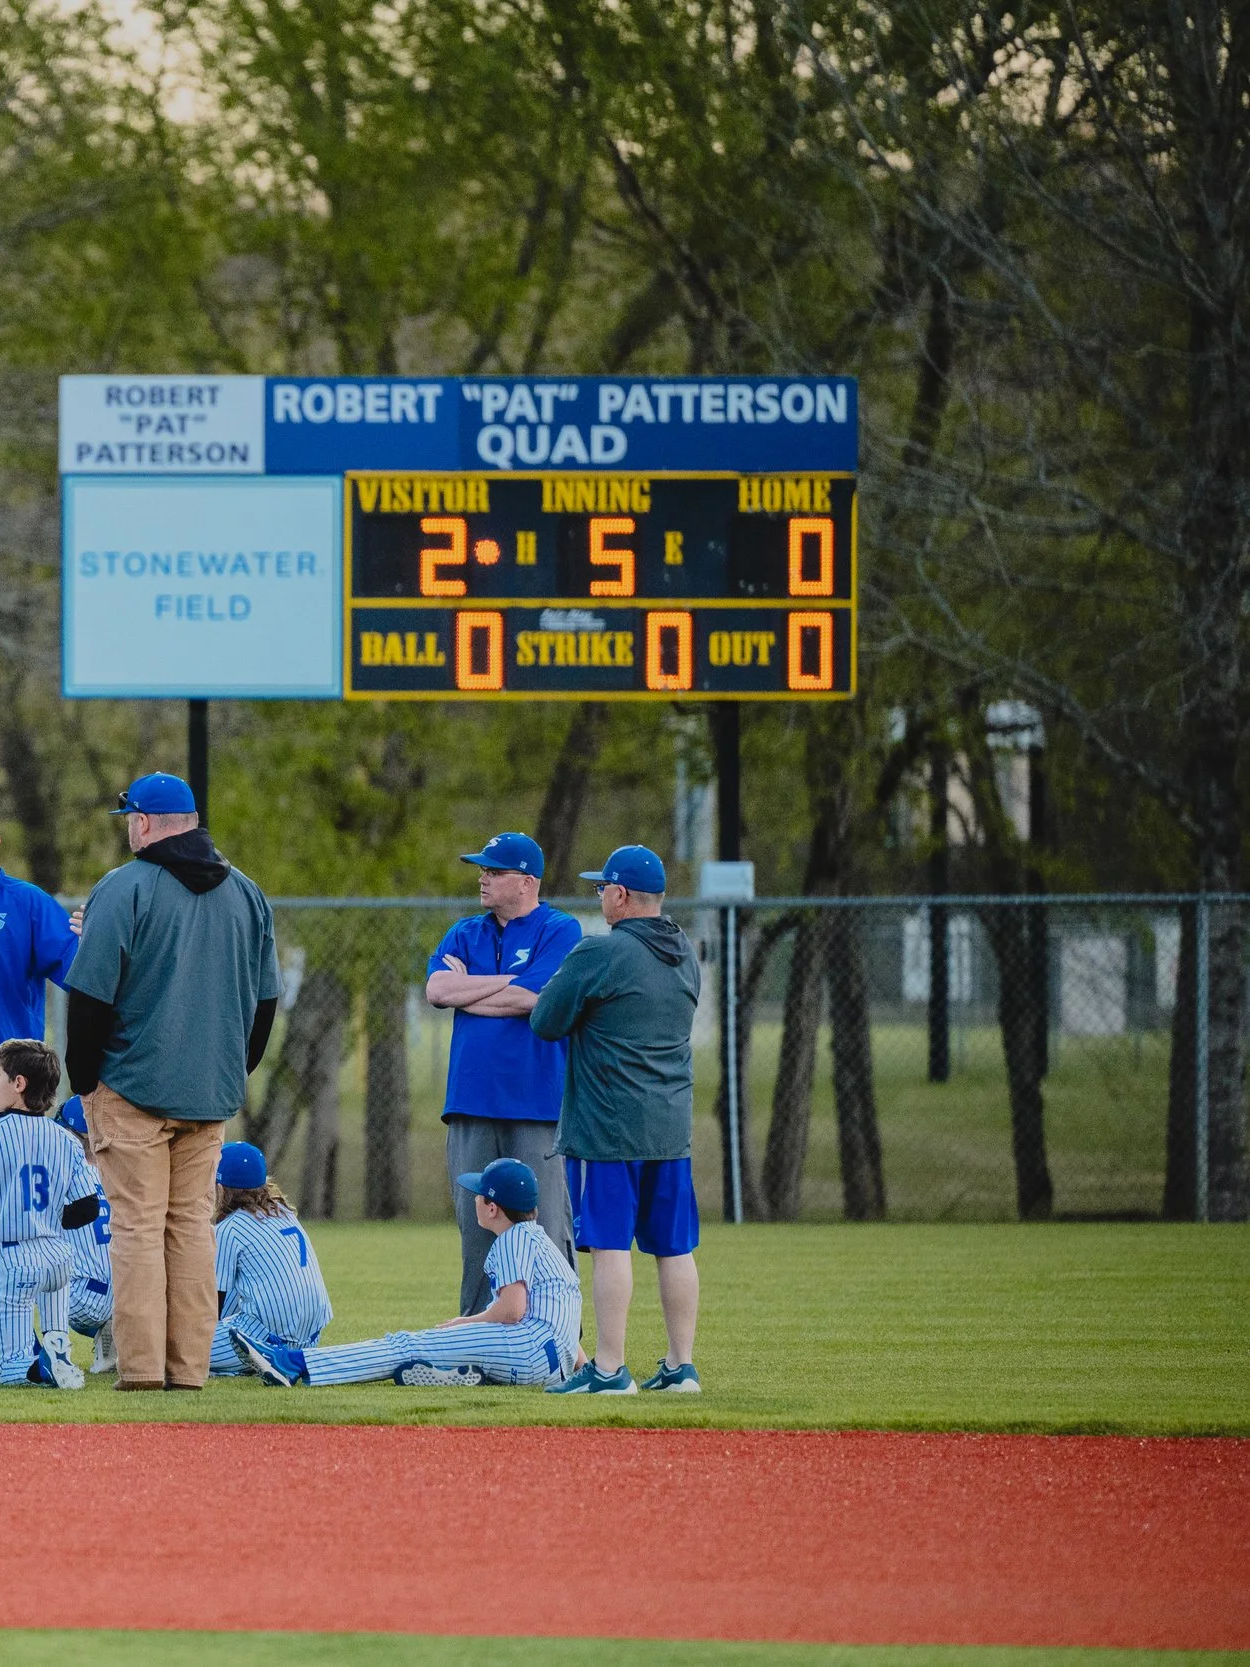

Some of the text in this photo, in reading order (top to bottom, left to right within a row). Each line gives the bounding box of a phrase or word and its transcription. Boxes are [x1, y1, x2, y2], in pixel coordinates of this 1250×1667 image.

[105, 384, 220, 408] ROBERT
[272, 383, 443, 424] ROBERT
[599, 383, 848, 424] PATTERSON
[76, 442, 249, 465] PATTERSON
[476, 424, 628, 470] QUAD
[357, 478, 832, 513] VISITOR INNING HOME
[78, 551, 319, 577] STONEWATER
[420, 517, 468, 597] 2
[589, 517, 636, 597] 5
[788, 517, 834, 597] 0
[155, 594, 252, 621] FIELD
[360, 631, 446, 667] BALL
[455, 610, 504, 691] 0
[516, 631, 635, 667] STRIKE
[646, 610, 693, 691] 0
[708, 631, 776, 667] OUT
[787, 610, 833, 691] 0
[19, 1164, 50, 1212] 13
[279, 1226, 307, 1268] 7
